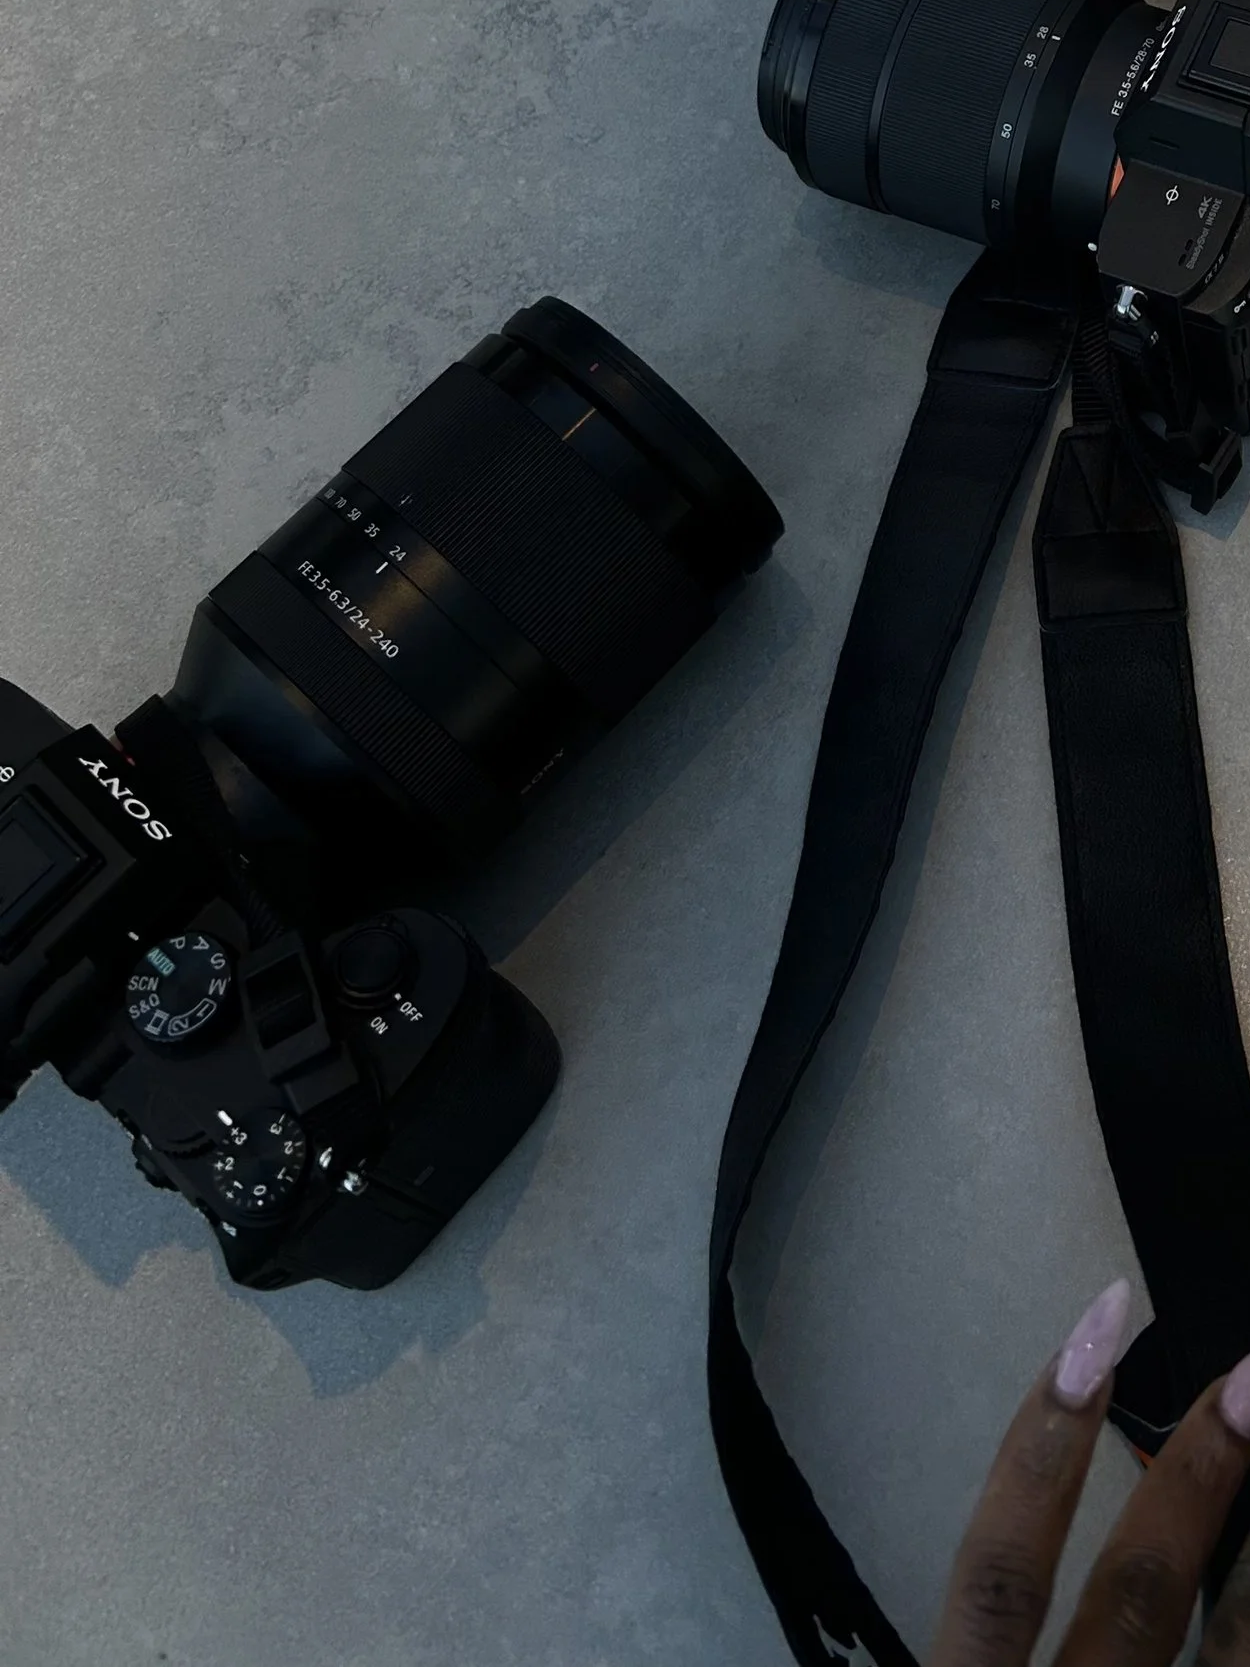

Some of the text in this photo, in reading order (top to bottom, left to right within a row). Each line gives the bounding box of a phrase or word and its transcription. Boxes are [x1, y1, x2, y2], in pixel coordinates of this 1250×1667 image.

[1035, 25, 1051, 41] 28
[1023, 51, 1038, 69] 35
[1110, 36, 1156, 117] FE 3.5-5.6/28-70
[1000, 121, 1015, 140] 50
[1197, 195, 1213, 220] 4K
[1204, 196, 1223, 228] INSIDE
[346, 506, 363, 522] 50
[363, 521, 382, 539] 35
[388, 543, 408, 563] 24
[78, 756, 173, 842] SONY
[169, 934, 187, 950] P
[191, 934, 211, 951] A
[146, 946, 176, 976] AUTO
[209, 952, 227, 970] S
[127, 974, 160, 991] SCN
[399, 1001, 424, 1023] OFF
[369, 1015, 389, 1035] ON
